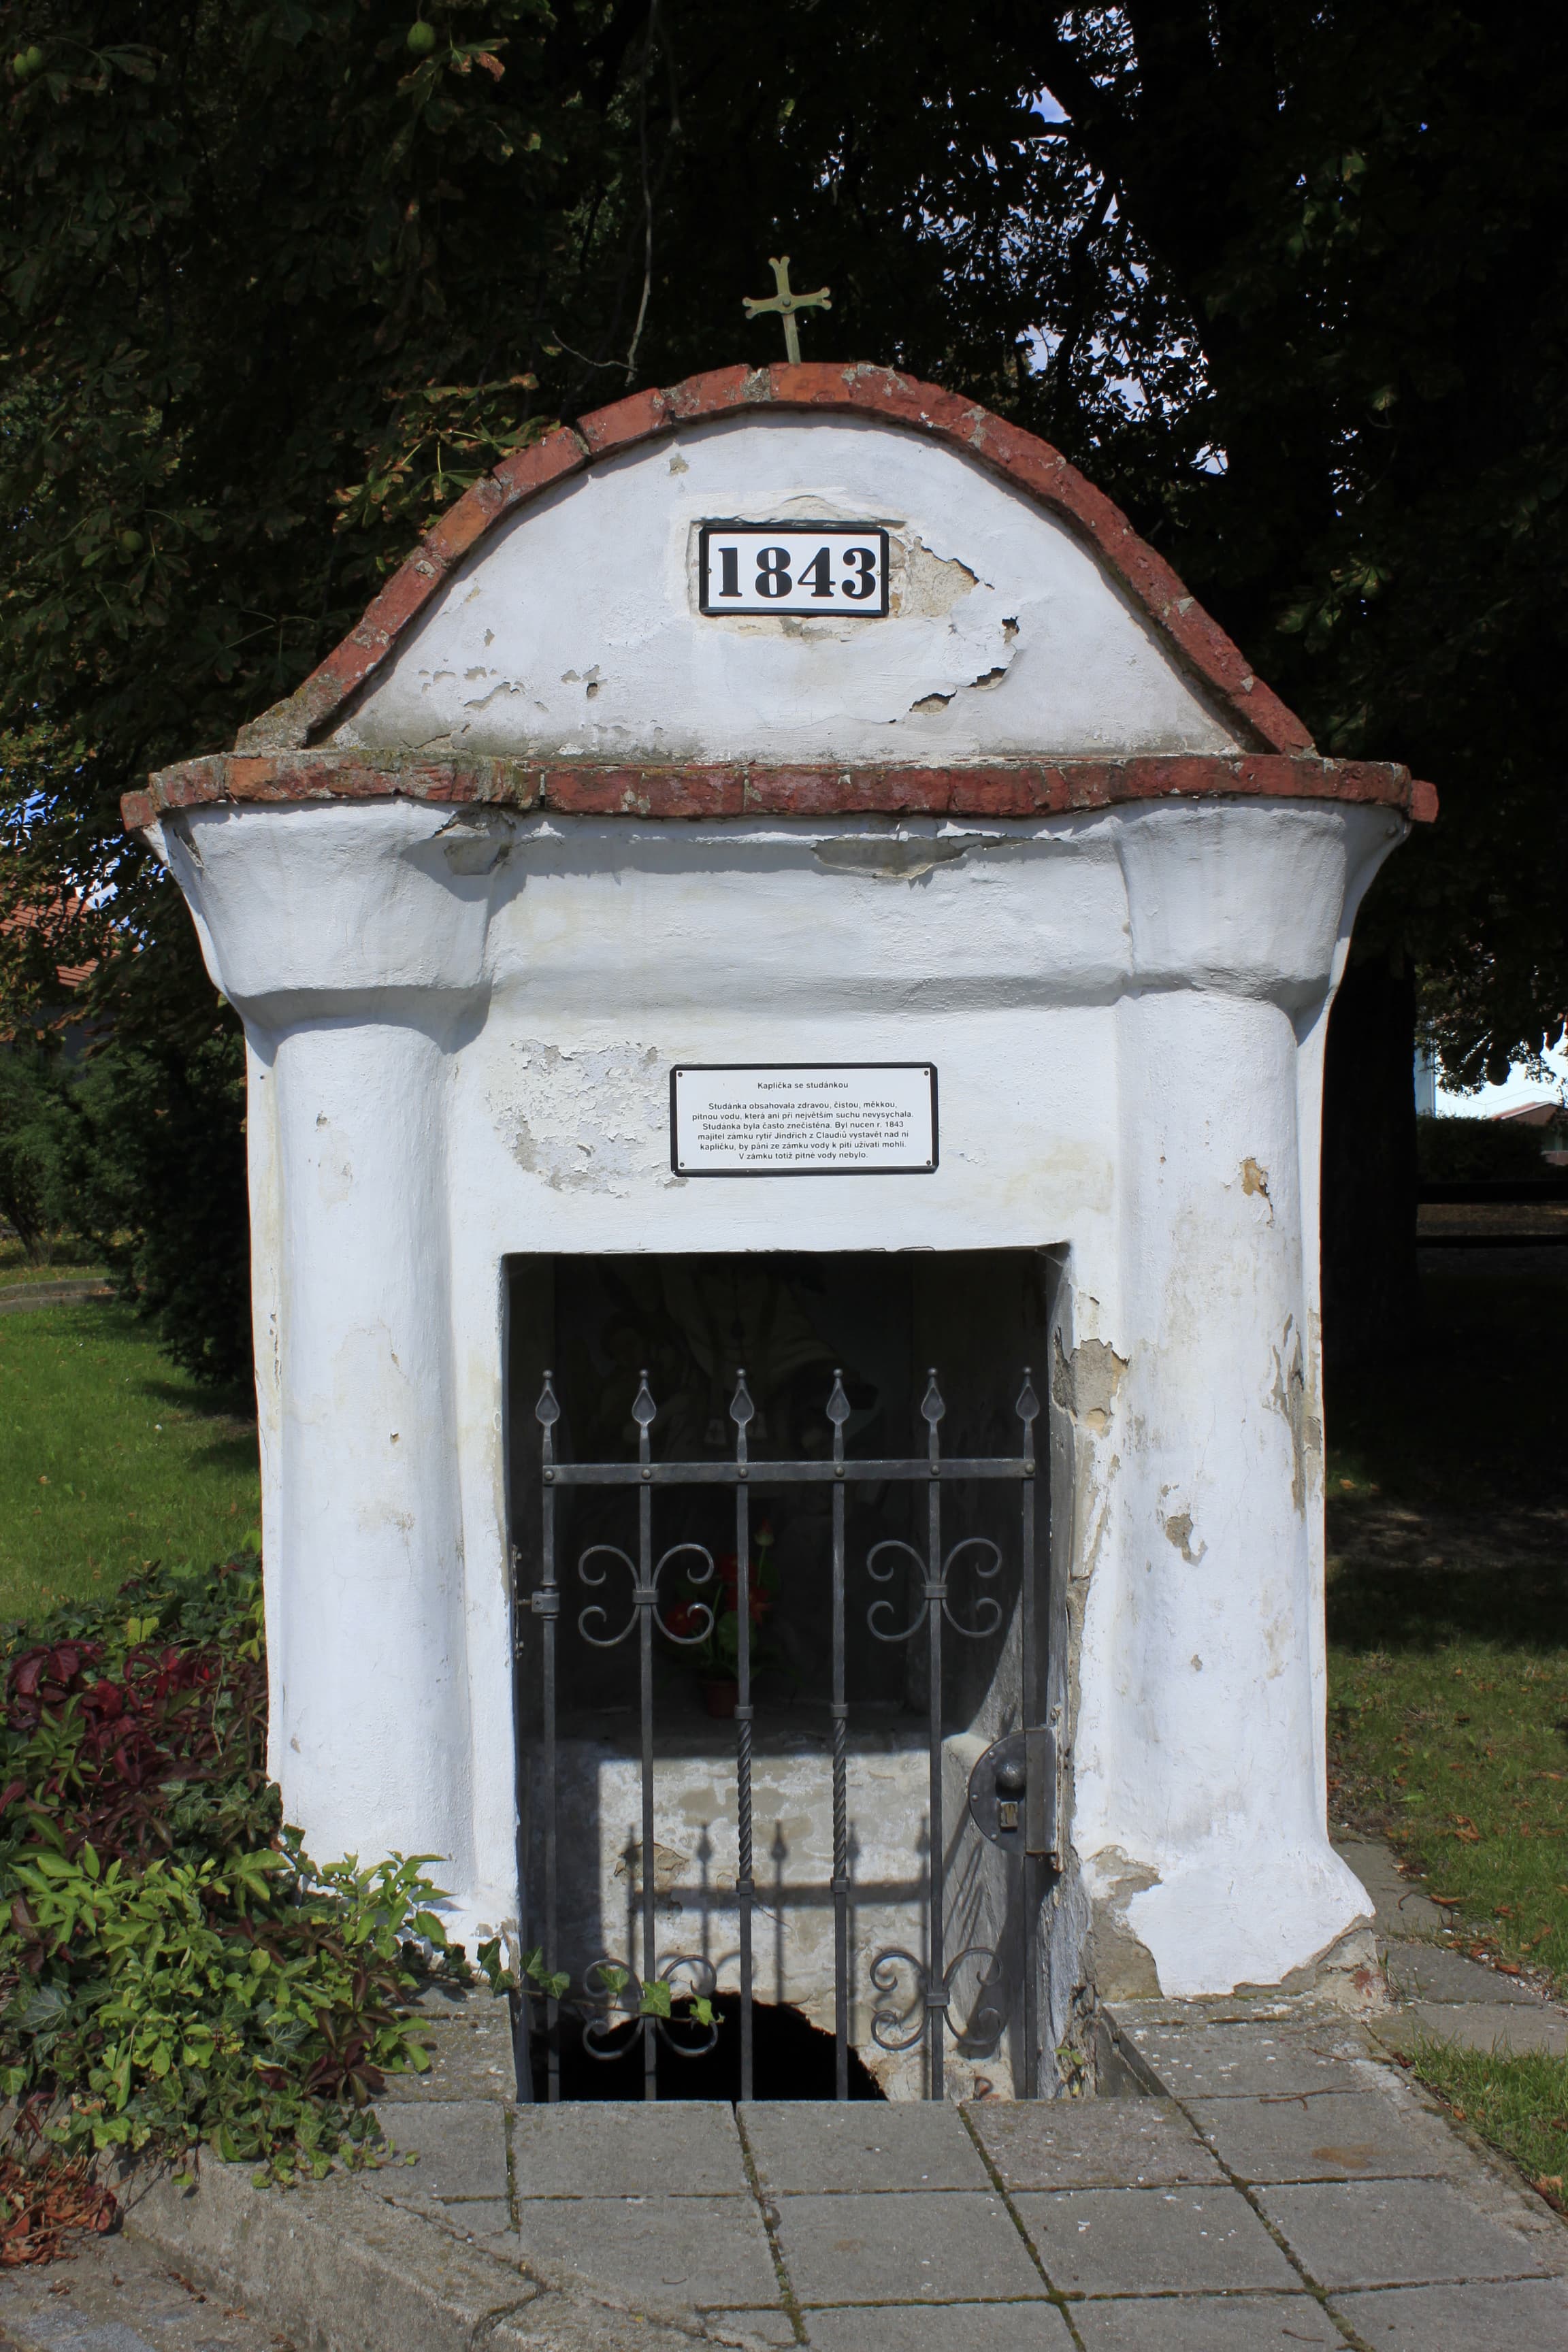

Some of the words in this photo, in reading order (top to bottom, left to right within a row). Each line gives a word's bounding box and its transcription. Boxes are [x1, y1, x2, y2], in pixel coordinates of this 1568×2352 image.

[718, 546, 877, 600] 1843
[758, 1082, 791, 1090] Kaplička
[834, 1101, 860, 1109] čistou,
[693, 1113, 717, 1122] pitnou
[782, 1112, 792, 1120] při
[863, 1111, 913, 1119] nevysychala.
[835, 1122, 847, 1130] Byl
[698, 1133, 724, 1141] majitel
[700, 1143, 736, 1152] kapličku,
[751, 1143, 768, 1151] páni
[839, 1152, 868, 1160] nebylo.
